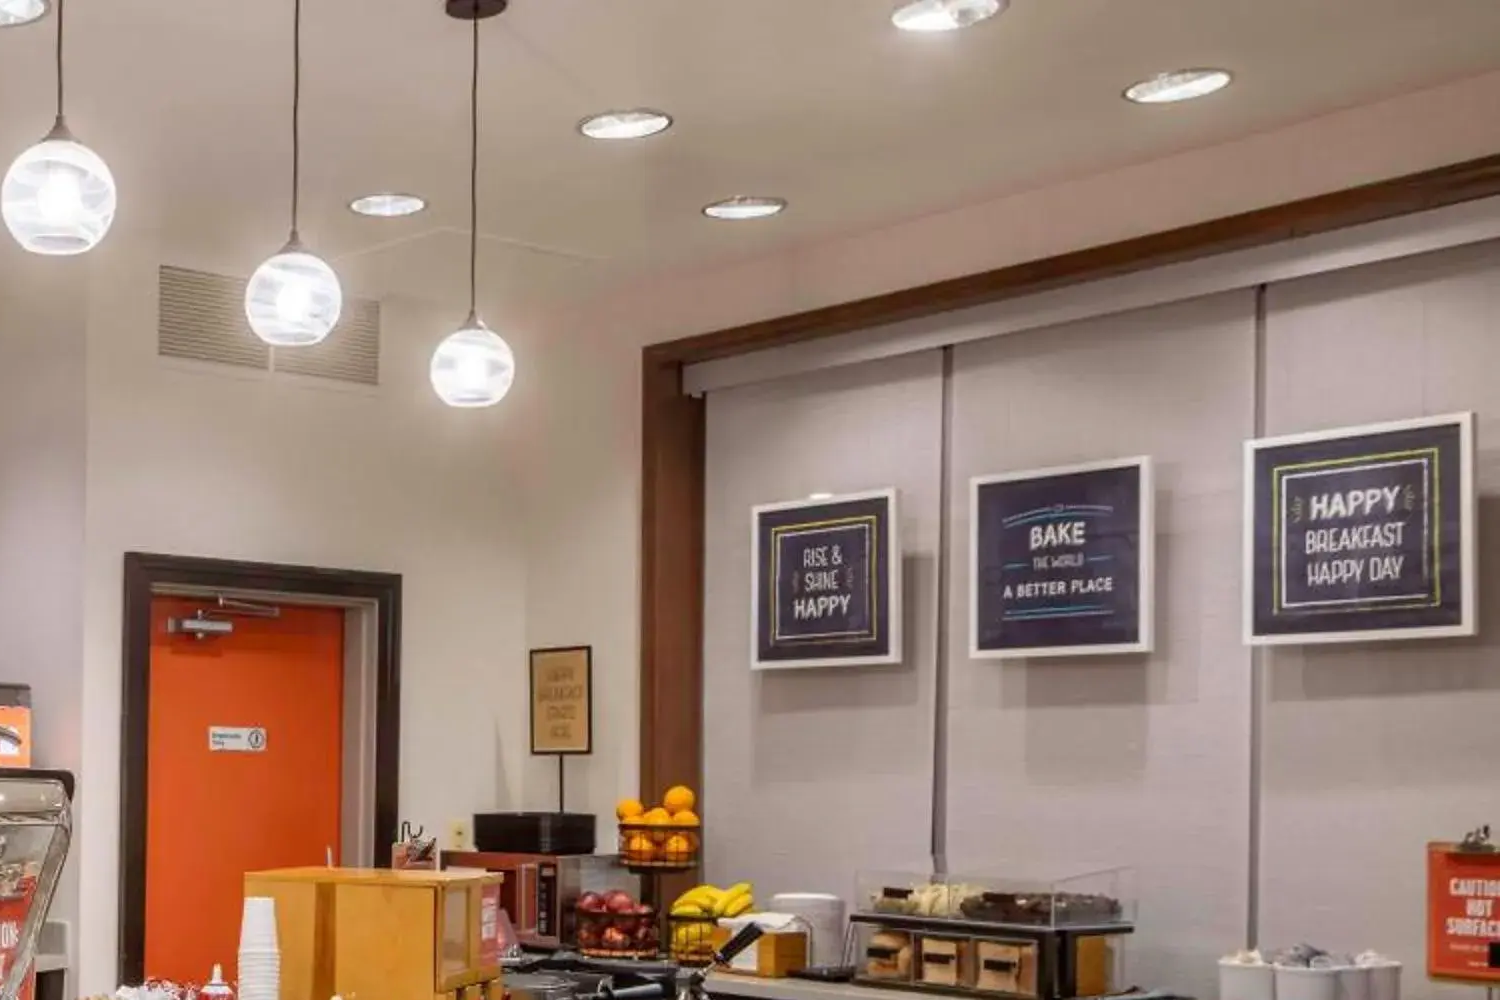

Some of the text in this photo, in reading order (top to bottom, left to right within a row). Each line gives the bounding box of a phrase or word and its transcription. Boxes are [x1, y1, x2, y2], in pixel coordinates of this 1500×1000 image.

[1309, 485, 1401, 521] HAPPY
[1030, 521, 1086, 550] BAKE
[1305, 521, 1404, 554] BREAKFAST
[803, 544, 843, 567] RISE &
[804, 569, 839, 592] SHINE
[1307, 556, 1404, 587] HAPPY DAY
[1003, 577, 1113, 599] A BETTER PLACE
[794, 594, 852, 619] HAPPY
[1449, 877, 1500, 896] CAUTIO
[1466, 899, 1492, 917] HOT
[1445, 917, 1500, 937] SURFAC
